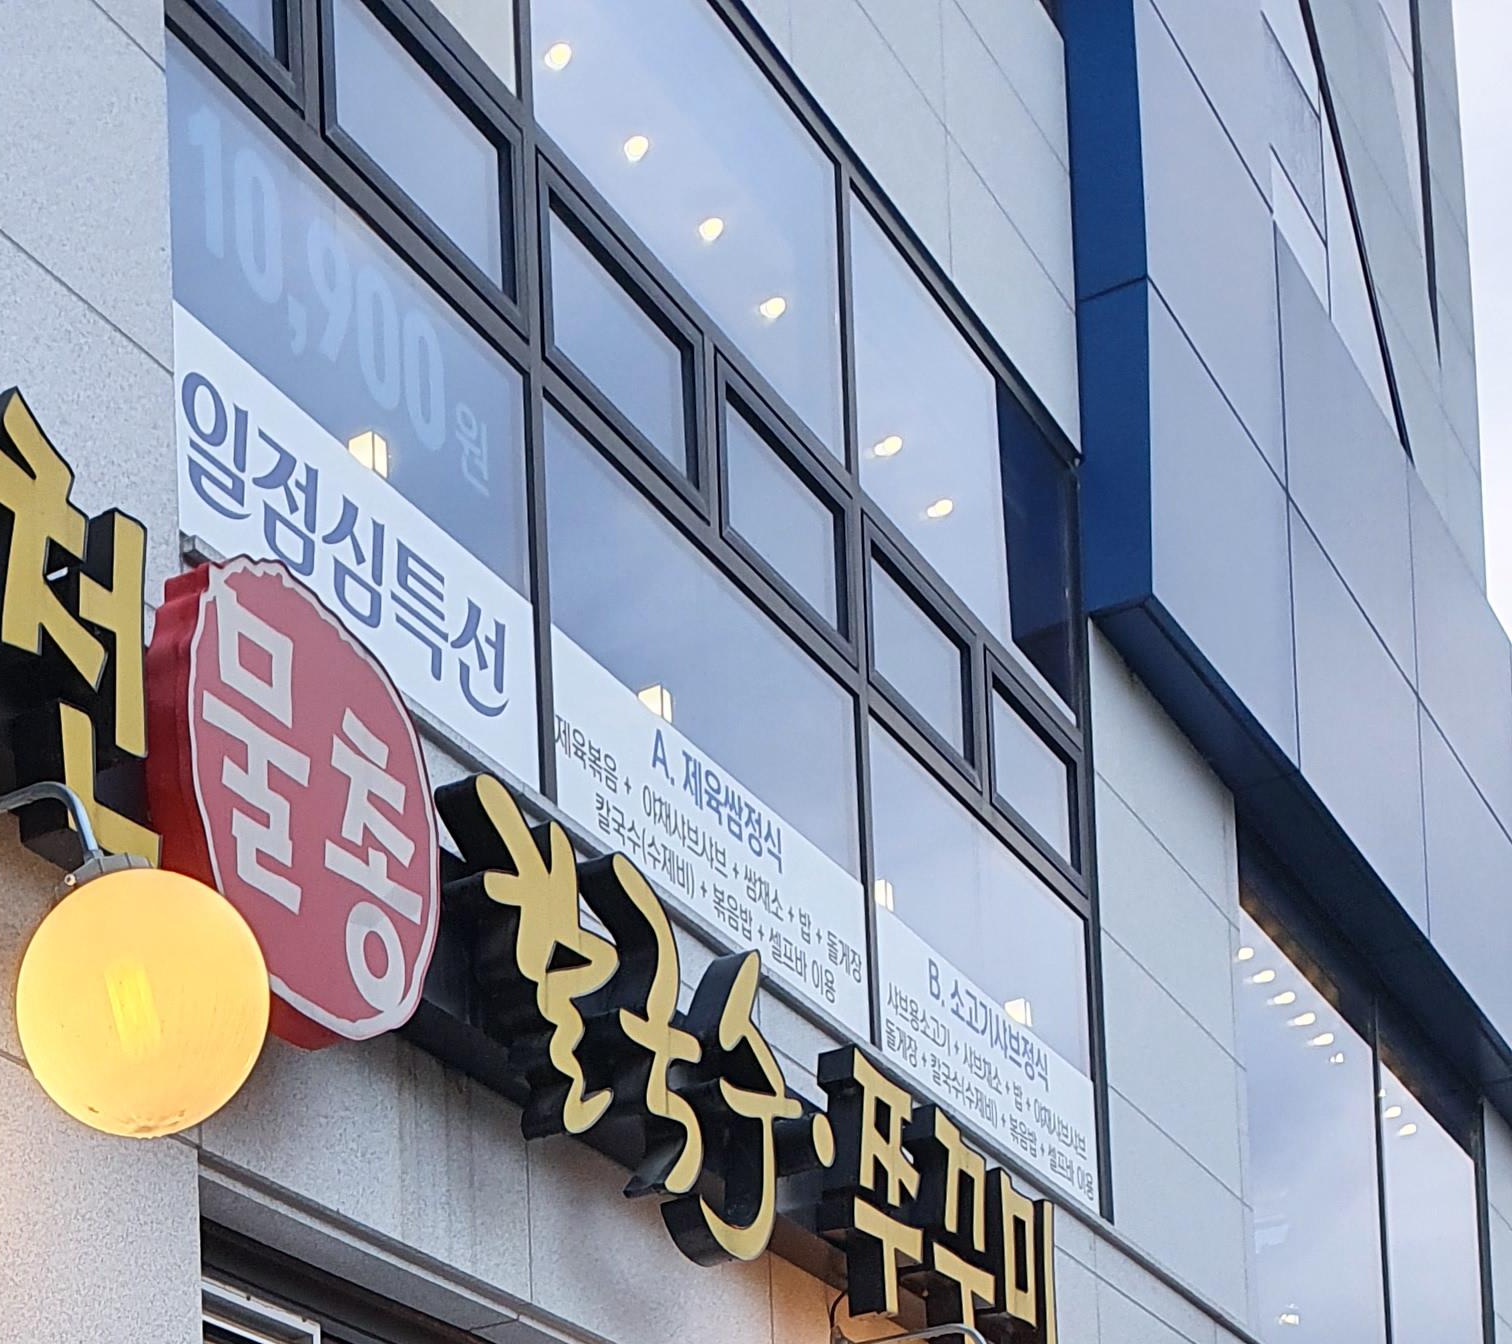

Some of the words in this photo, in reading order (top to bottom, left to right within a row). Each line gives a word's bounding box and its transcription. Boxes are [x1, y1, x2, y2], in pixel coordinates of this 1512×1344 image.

[202, 588, 425, 1016] 물총
[554, 714, 619, 794] 제육볶음
[642, 785, 729, 879] 야채샤브샤브
[744, 863, 785, 920] 쌈채소
[798, 909, 812, 945] 밥
[826, 930, 863, 984] 돌게장
[595, 792, 696, 899] 칼국수(수제비)
[712, 883, 754, 942] 볶음밥
[769, 926, 807, 983] 셀프바
[811, 958, 837, 1004] 이용
[681, 749, 784, 874] 제육쌈정식
[950, 979, 1050, 1092] 소고기샤브정식
